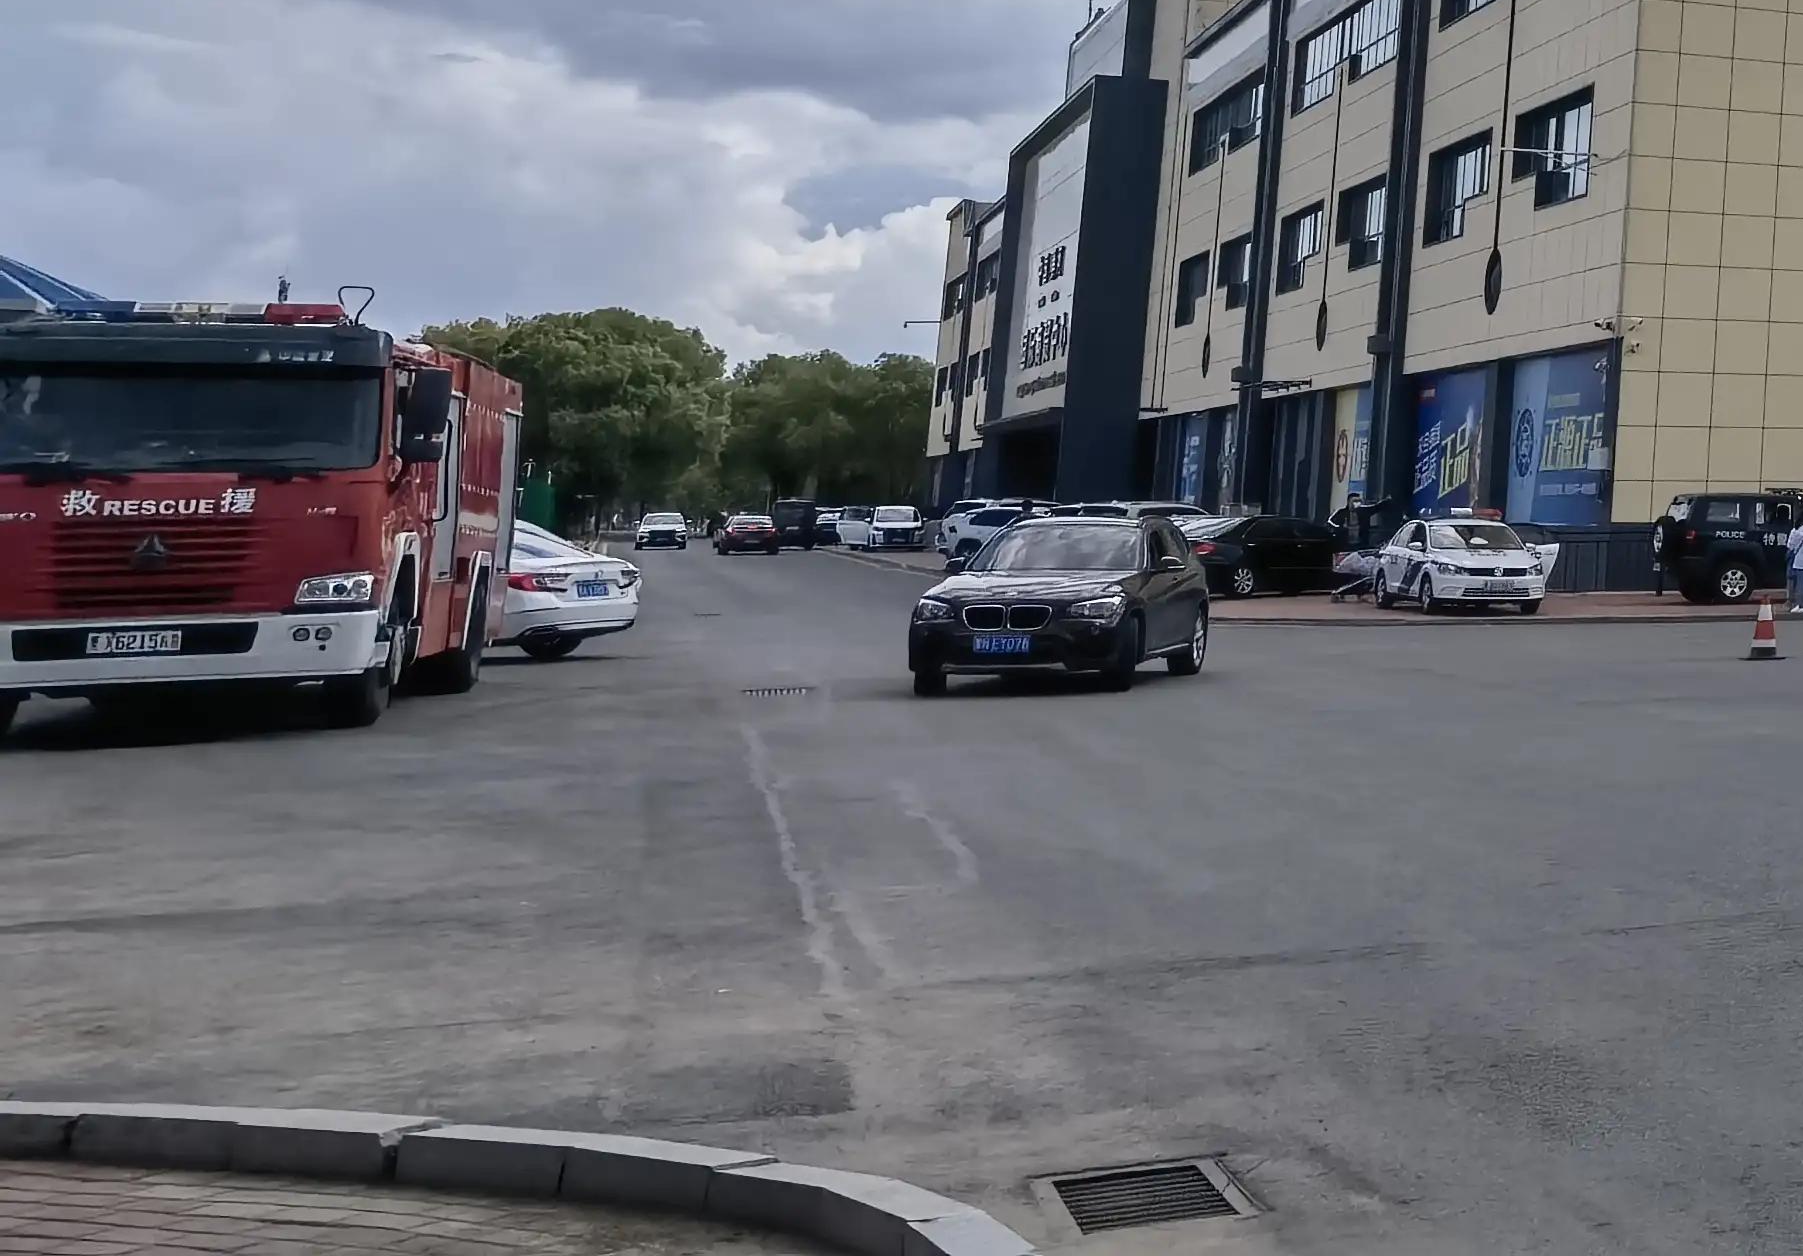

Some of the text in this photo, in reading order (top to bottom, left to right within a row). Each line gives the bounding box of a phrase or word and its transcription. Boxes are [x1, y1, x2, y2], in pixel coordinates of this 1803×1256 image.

[61, 490, 101, 517] 救
[103, 499, 215, 516] RESCUE
[220, 488, 256, 513] 援
[1715, 530, 1745, 539] POLICE
